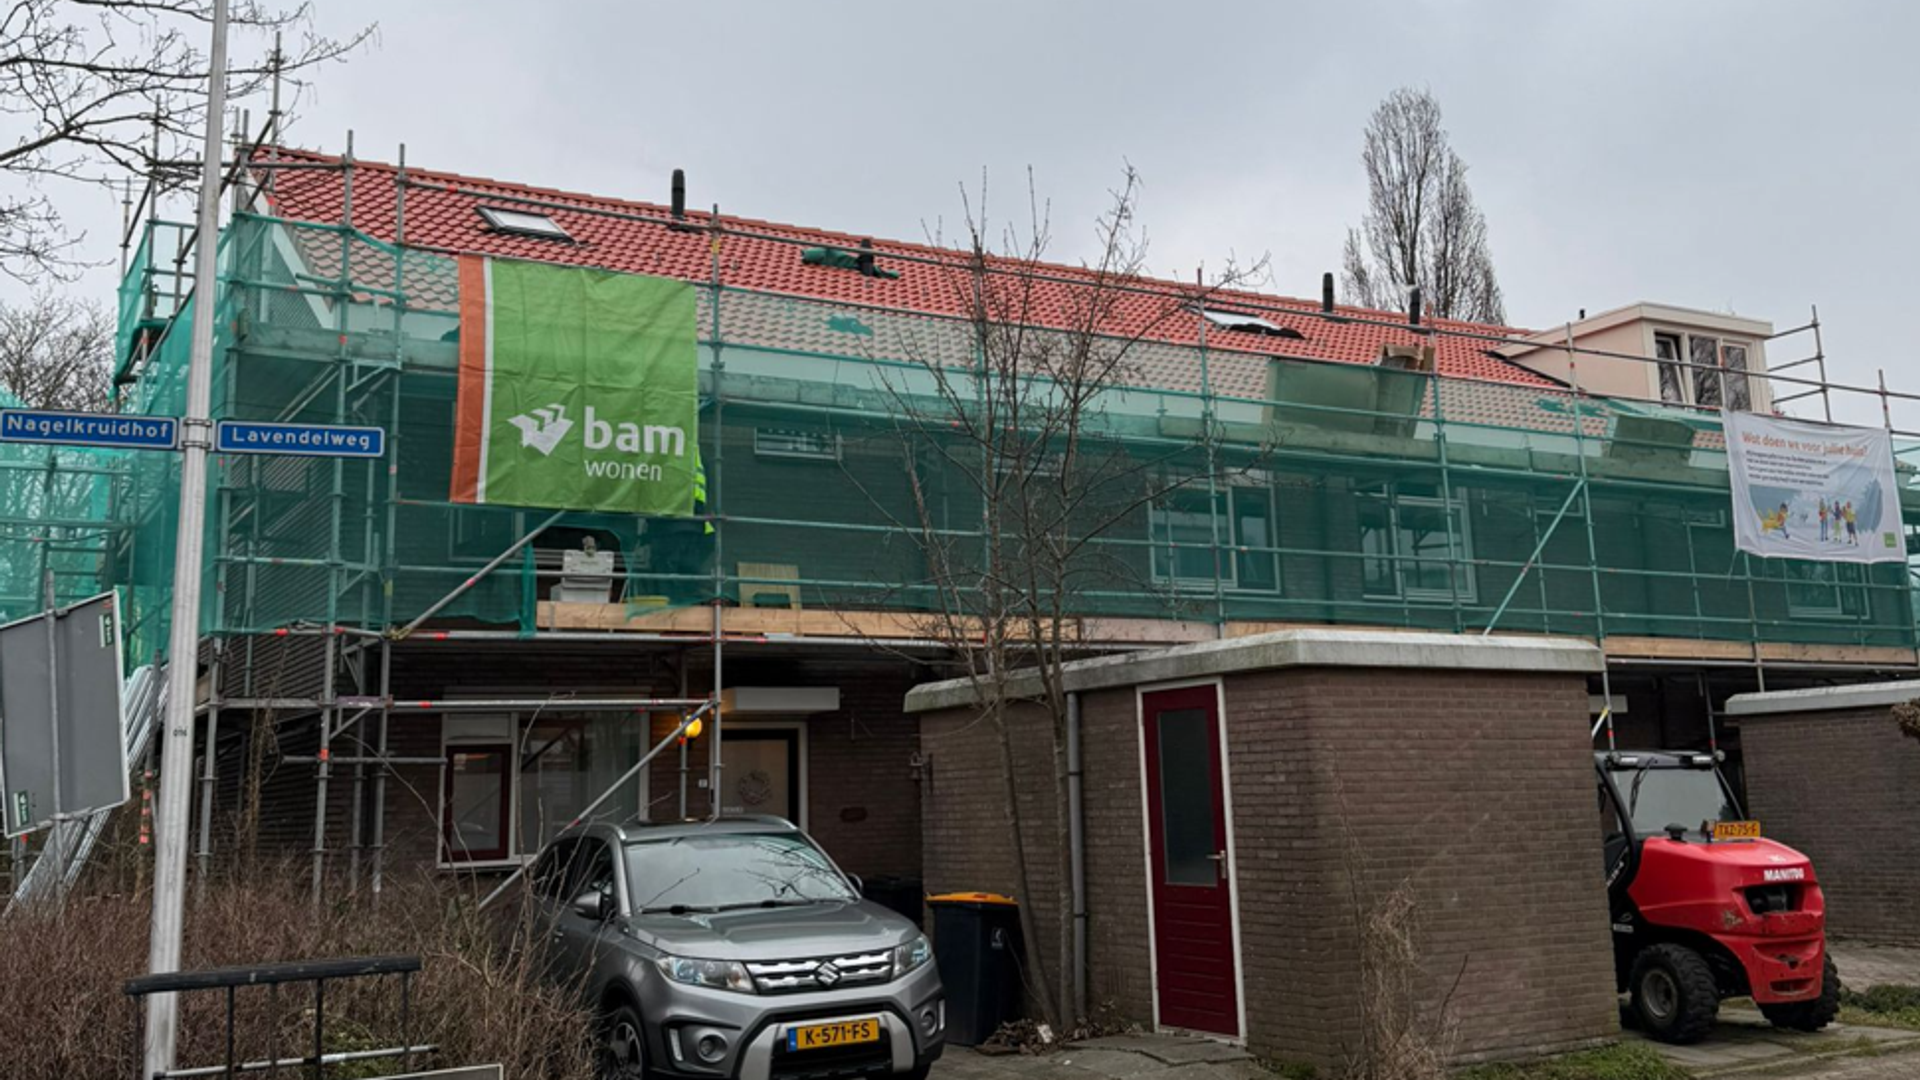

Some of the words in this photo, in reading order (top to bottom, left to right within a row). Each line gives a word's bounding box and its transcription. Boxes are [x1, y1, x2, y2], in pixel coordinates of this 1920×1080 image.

[7, 414, 170, 439] Nagelkruidhof
[583, 405, 685, 457] bam
[231, 427, 371, 451] Lavendelweg
[584, 460, 662, 482] wonen
[805, 1022, 871, 1046] K-571-FS
